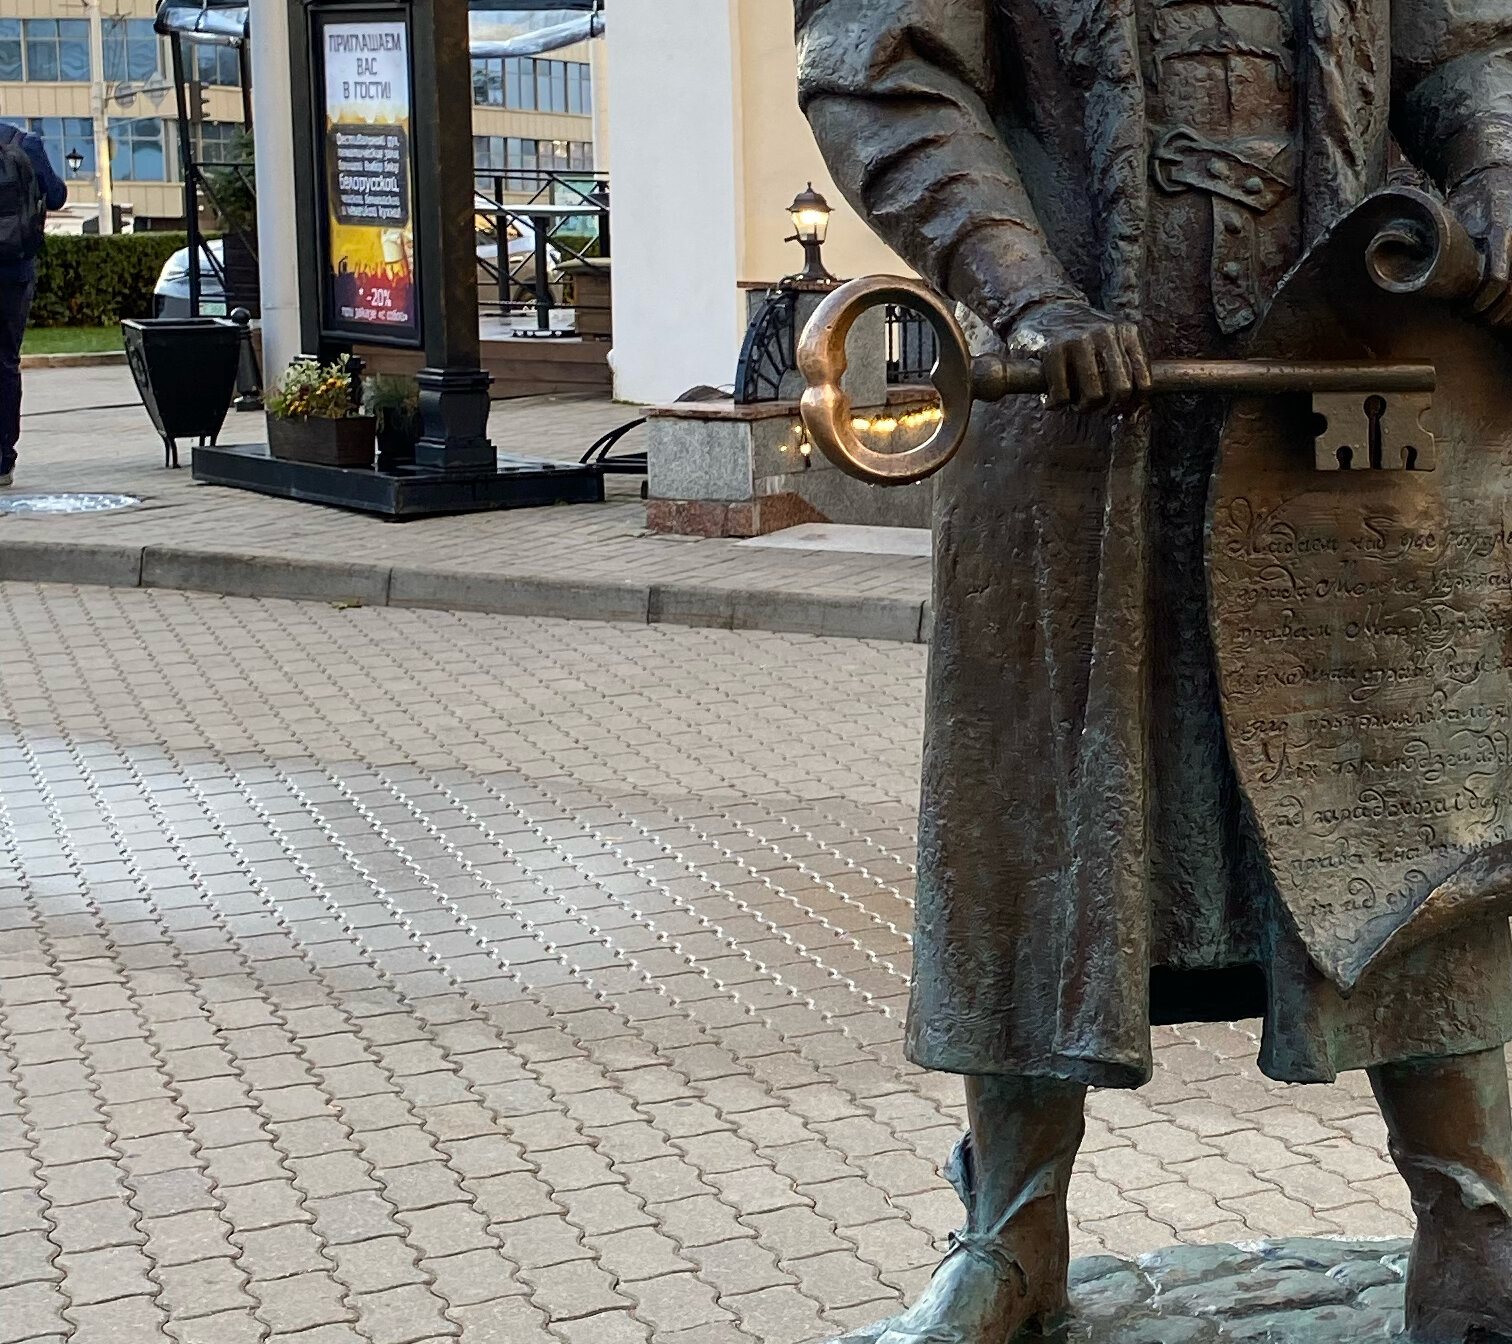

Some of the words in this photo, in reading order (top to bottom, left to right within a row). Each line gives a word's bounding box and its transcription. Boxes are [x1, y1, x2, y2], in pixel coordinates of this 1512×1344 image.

[328, 33, 402, 53] ПРИГЛАШАЕМ
[356, 57, 378, 77] ВАС
[342, 81, 351, 99] В
[354, 81, 392, 100] ГОСТИ!
